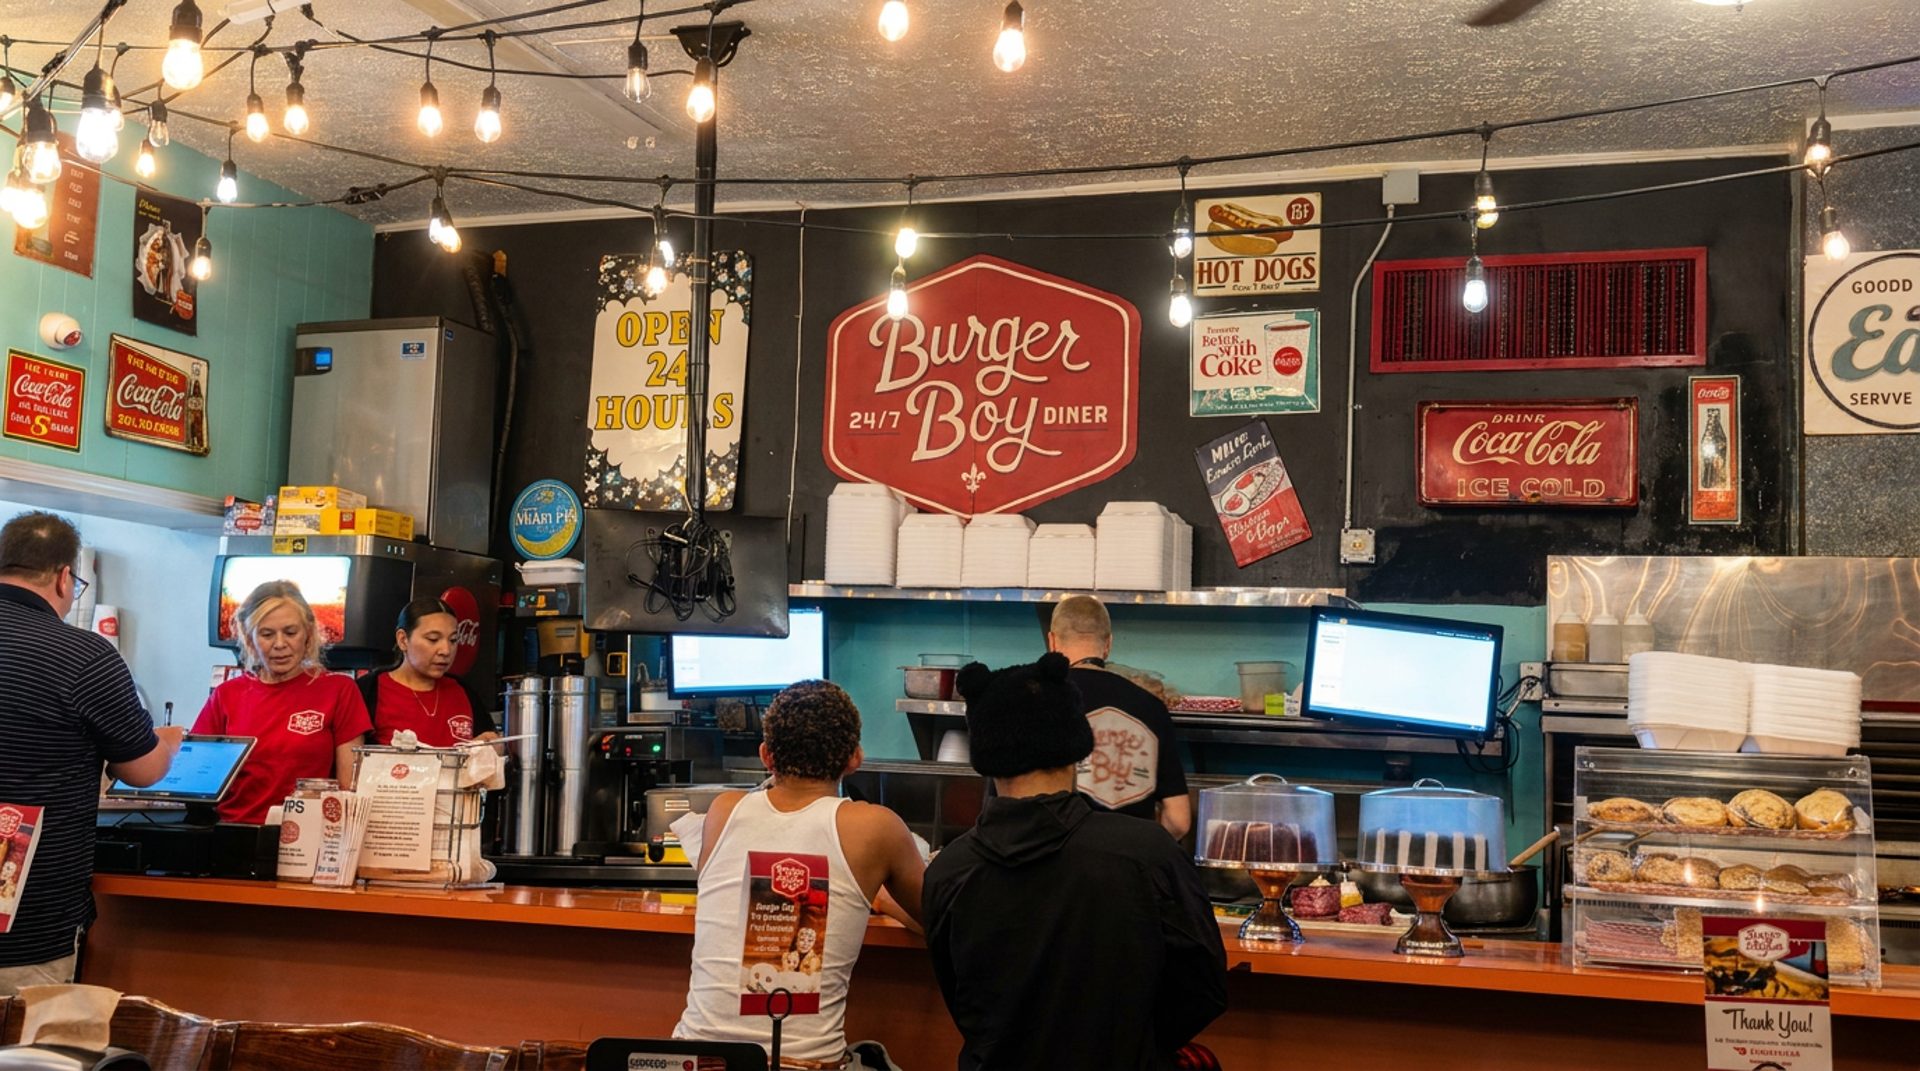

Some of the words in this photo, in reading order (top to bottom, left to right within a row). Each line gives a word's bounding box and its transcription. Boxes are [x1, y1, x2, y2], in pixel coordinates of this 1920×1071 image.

[1198, 260, 1244, 284] HOT
[1254, 256, 1316, 283] DOGS
[1851, 278, 1913, 294] GOODD
[645, 350, 688, 388] 24
[868, 312, 1090, 397] Burger
[1199, 353, 1262, 378] Coke
[594, 392, 734, 431] HOUS
[849, 410, 901, 429] 24/7
[905, 380, 1062, 474] Boy
[1043, 405, 1108, 425] DINER
[1492, 413, 1546, 425] DRINK
[1451, 418, 1607, 466] Coca-Cola
[1457, 477, 1510, 498] ICE
[1520, 477, 1606, 498] COLD
[1722, 1008, 1775, 1032] Thank
[1778, 1011, 1813, 1039] You!
